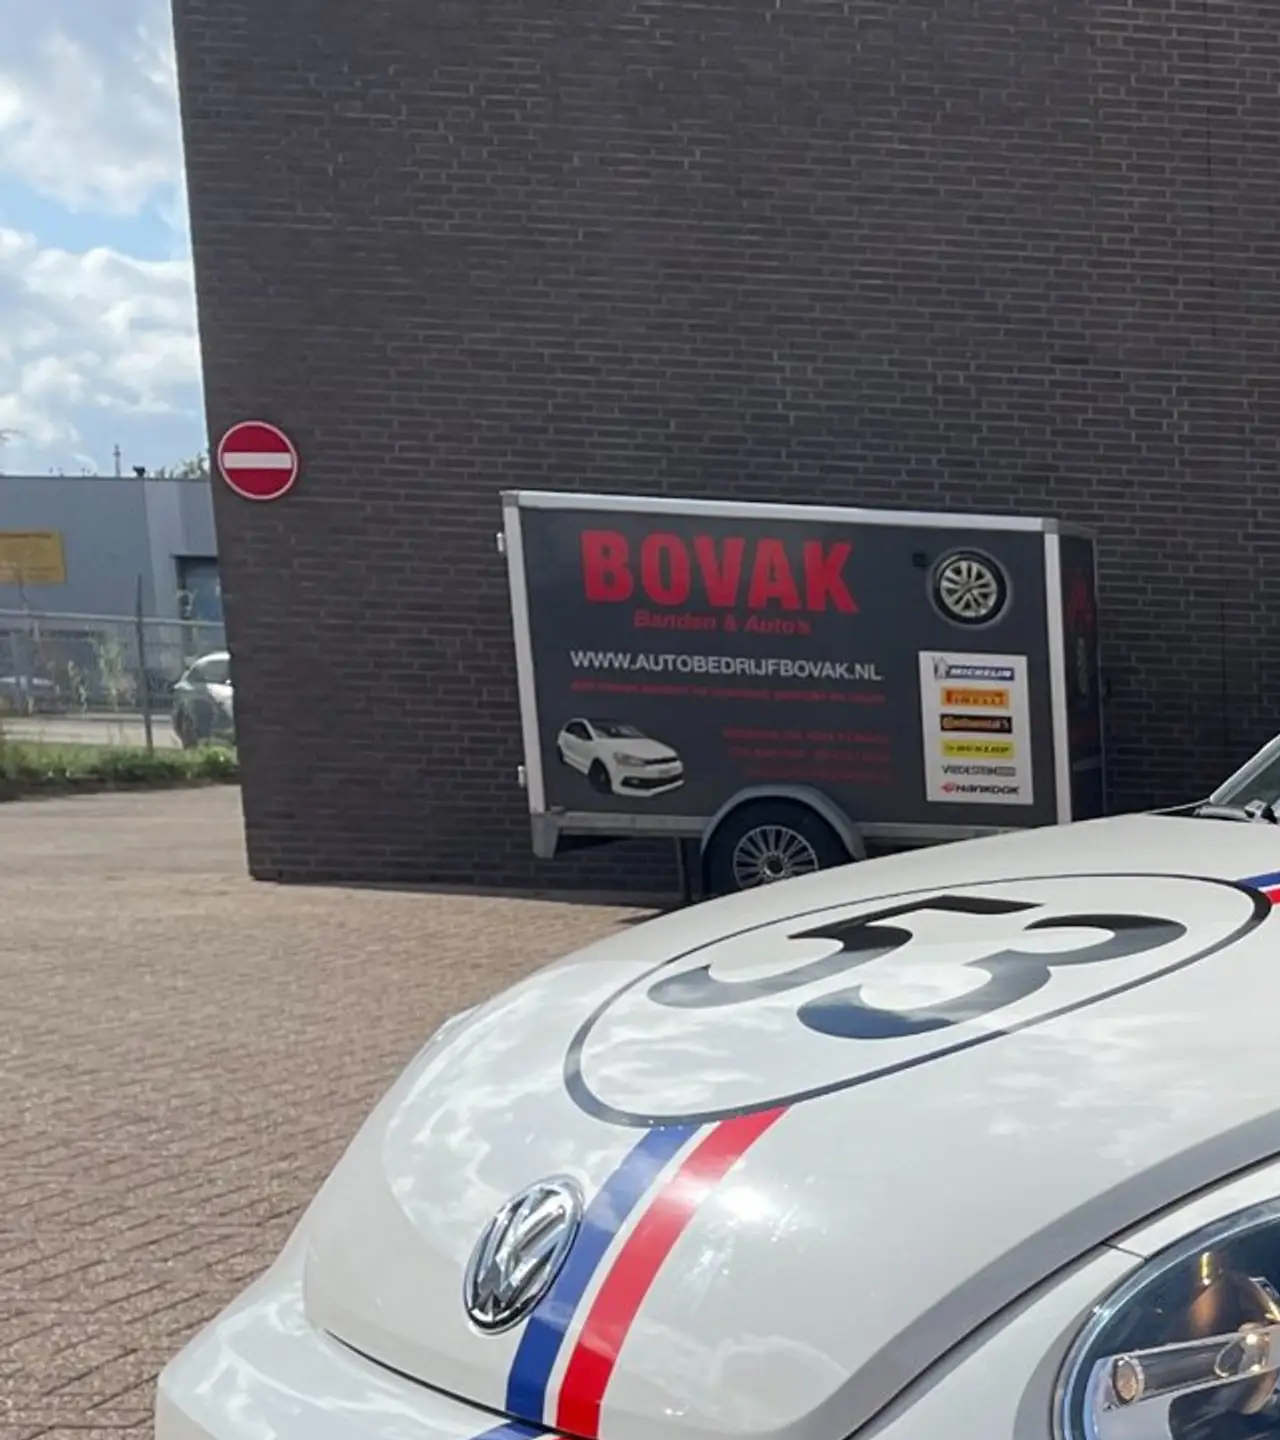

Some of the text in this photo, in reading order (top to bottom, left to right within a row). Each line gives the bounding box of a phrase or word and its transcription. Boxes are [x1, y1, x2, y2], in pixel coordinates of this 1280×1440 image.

[580, 528, 860, 614] BOVAK
[570, 650, 882, 681] WWW.AUTOBEDRIJFBOVAK.NL
[646, 894, 1187, 1040] 53
